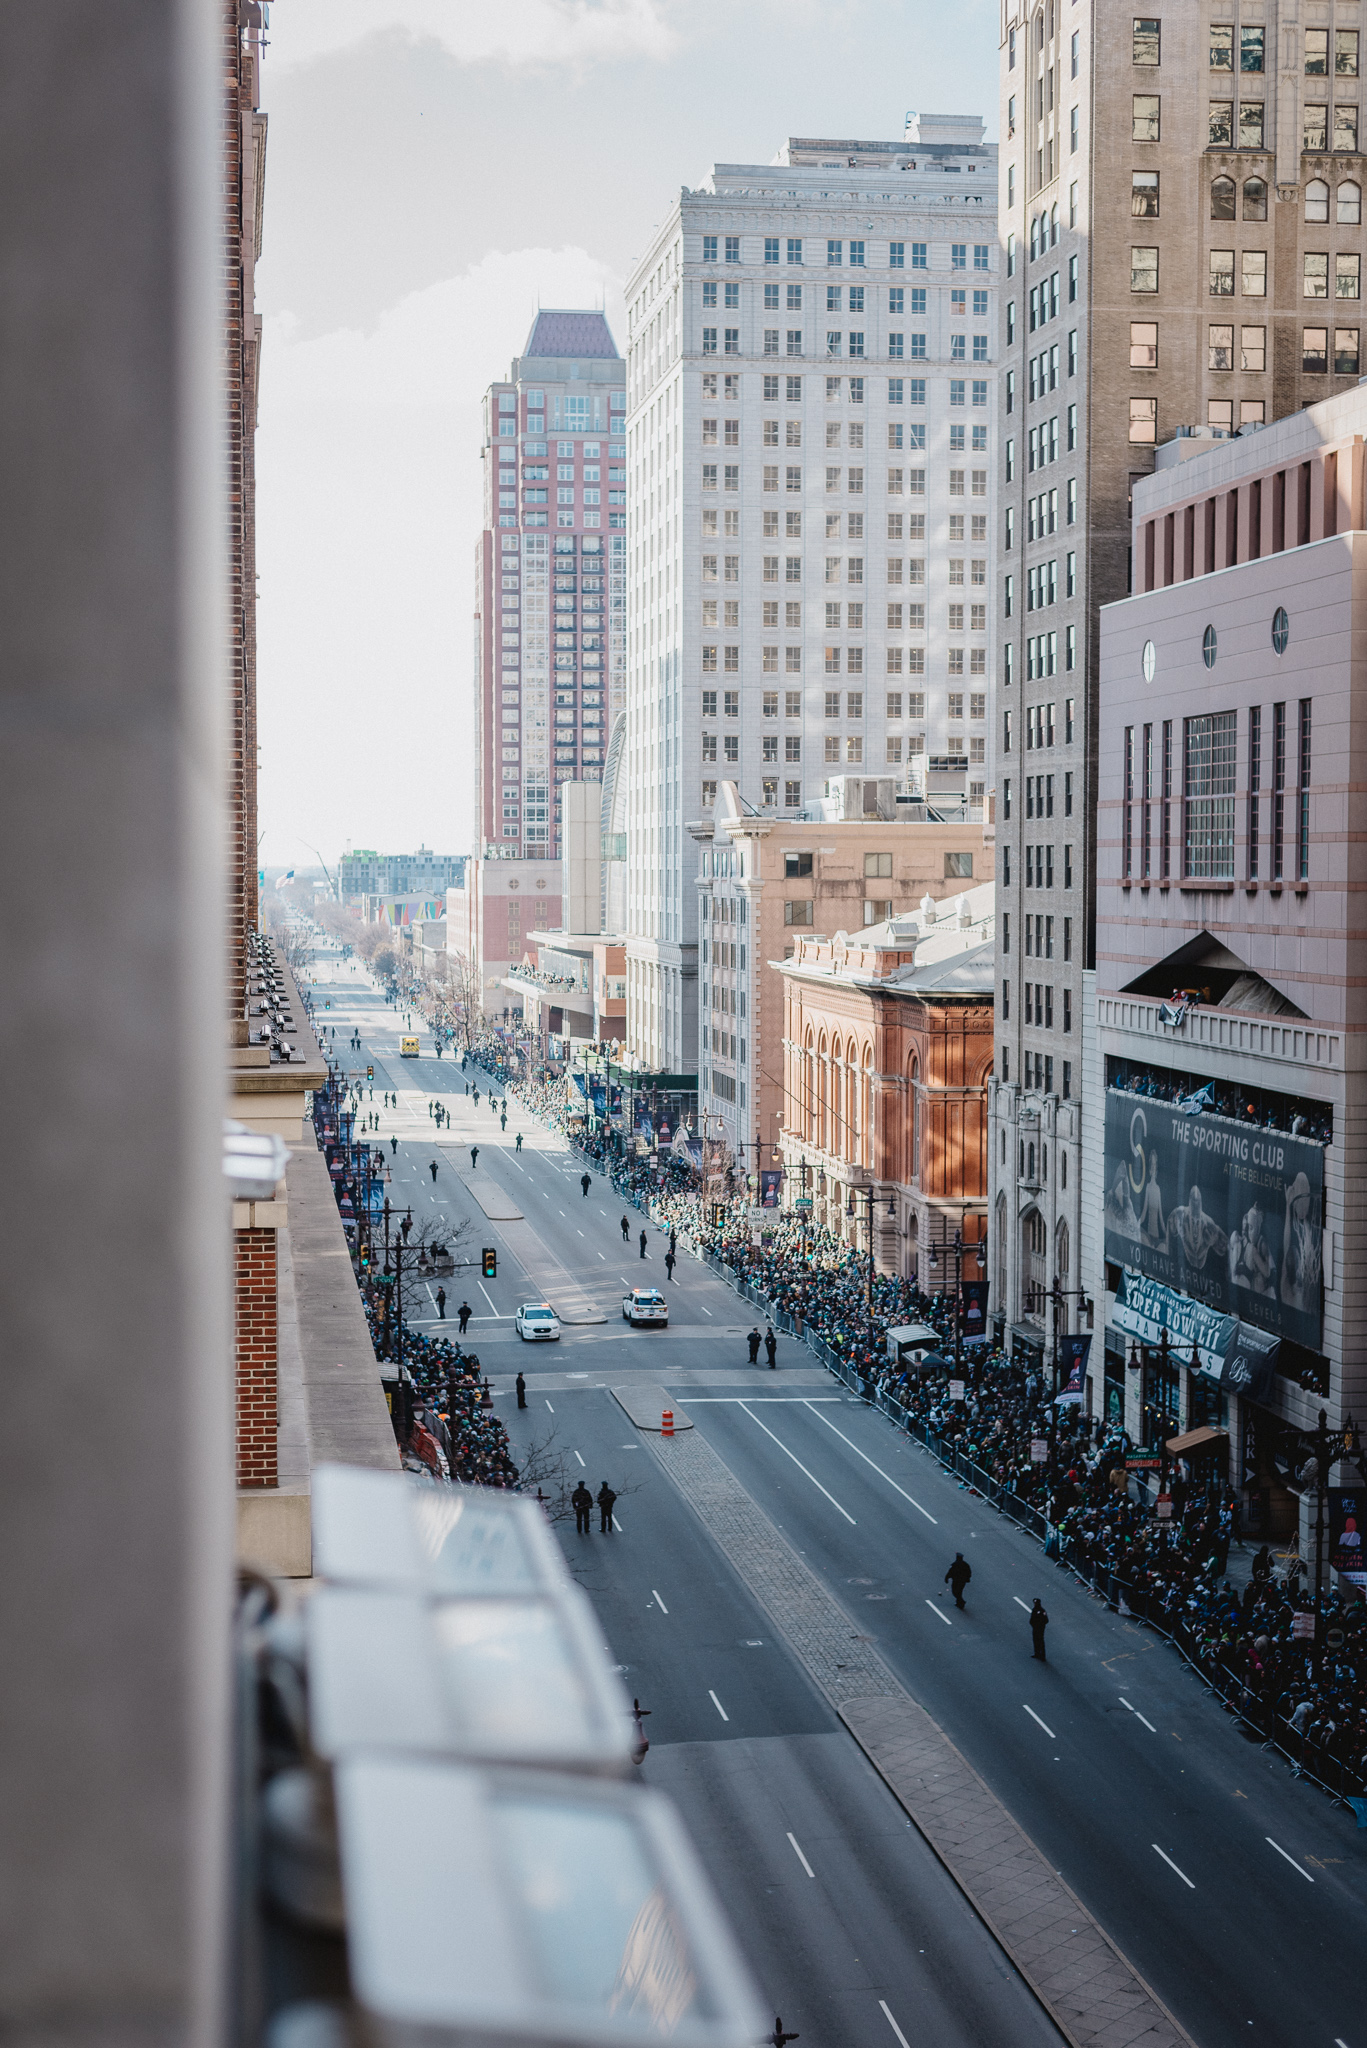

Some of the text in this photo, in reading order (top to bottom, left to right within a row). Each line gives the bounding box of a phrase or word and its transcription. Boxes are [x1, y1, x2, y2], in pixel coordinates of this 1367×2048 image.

[1171, 1119, 1284, 1170] THE SPORTING CLUB
[1223, 1162, 1283, 1192] AT THE BELLEVUE
[1129, 1244, 1223, 1300] YOU HAVE ARRIVED
[1126, 1288, 1161, 1321] SUPER
[1166, 1307, 1195, 1340] BOWL
[1250, 1301, 1275, 1323] LEVEL
